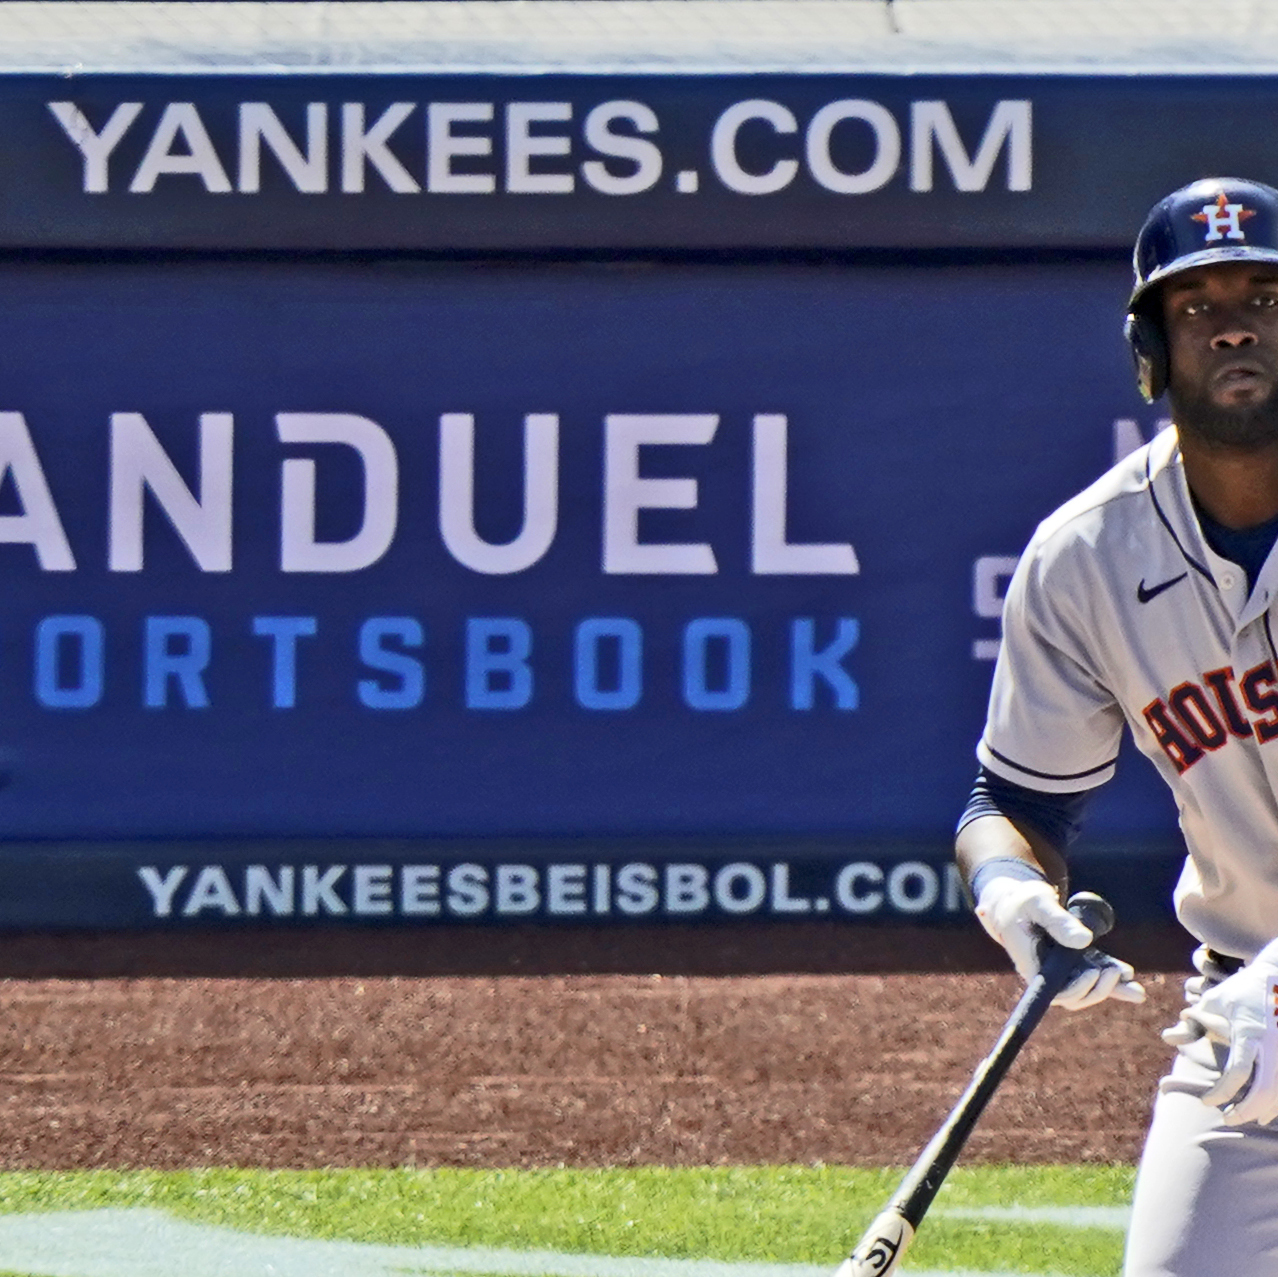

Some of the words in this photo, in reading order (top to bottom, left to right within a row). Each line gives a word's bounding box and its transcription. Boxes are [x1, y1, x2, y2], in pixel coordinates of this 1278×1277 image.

[50, 100, 1032, 194] YANKEES.COM
[1203, 204, 1244, 241] H
[35, 615, 860, 711] ORTSBOOK
